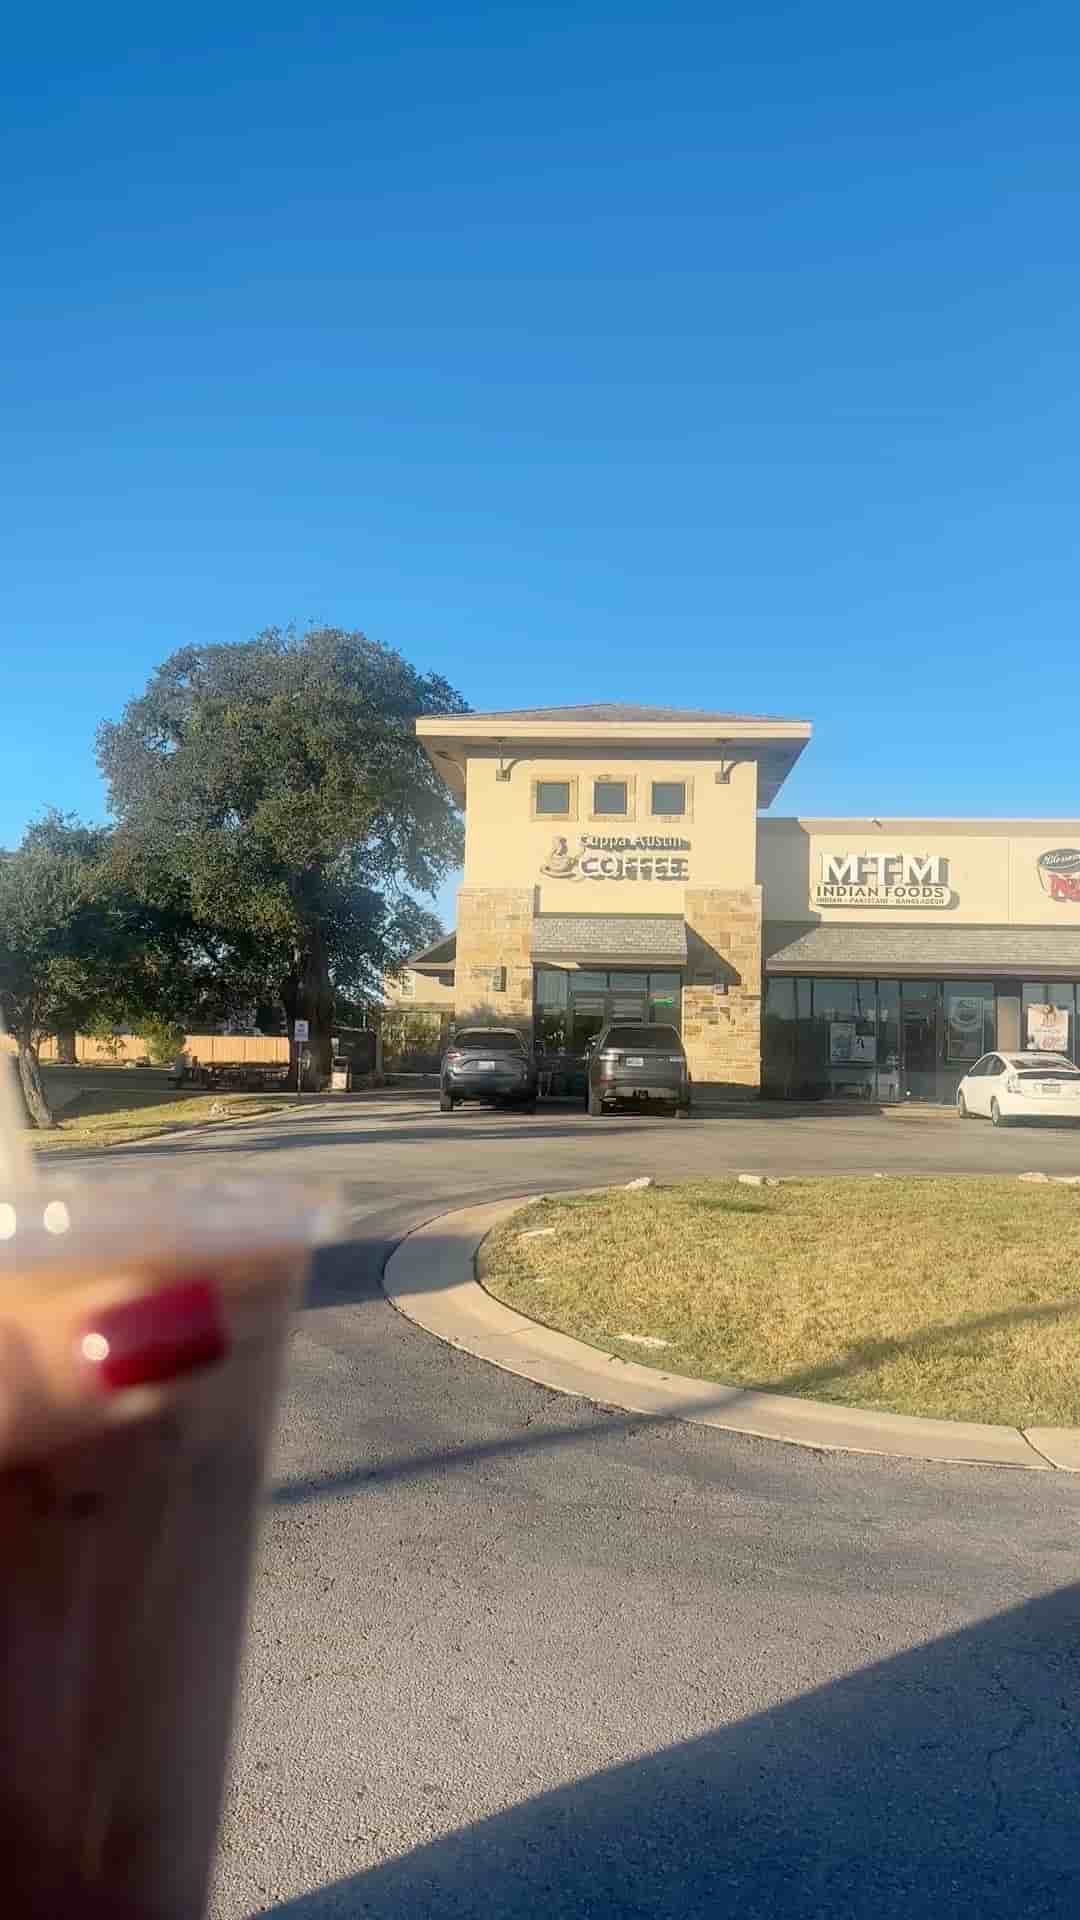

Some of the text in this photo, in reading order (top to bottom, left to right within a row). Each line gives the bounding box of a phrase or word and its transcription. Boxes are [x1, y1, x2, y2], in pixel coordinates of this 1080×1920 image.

[630, 833, 685, 850] Austin
[578, 855, 689, 880] COFFEE
[816, 886, 945, 898] INDIAN FOODS
